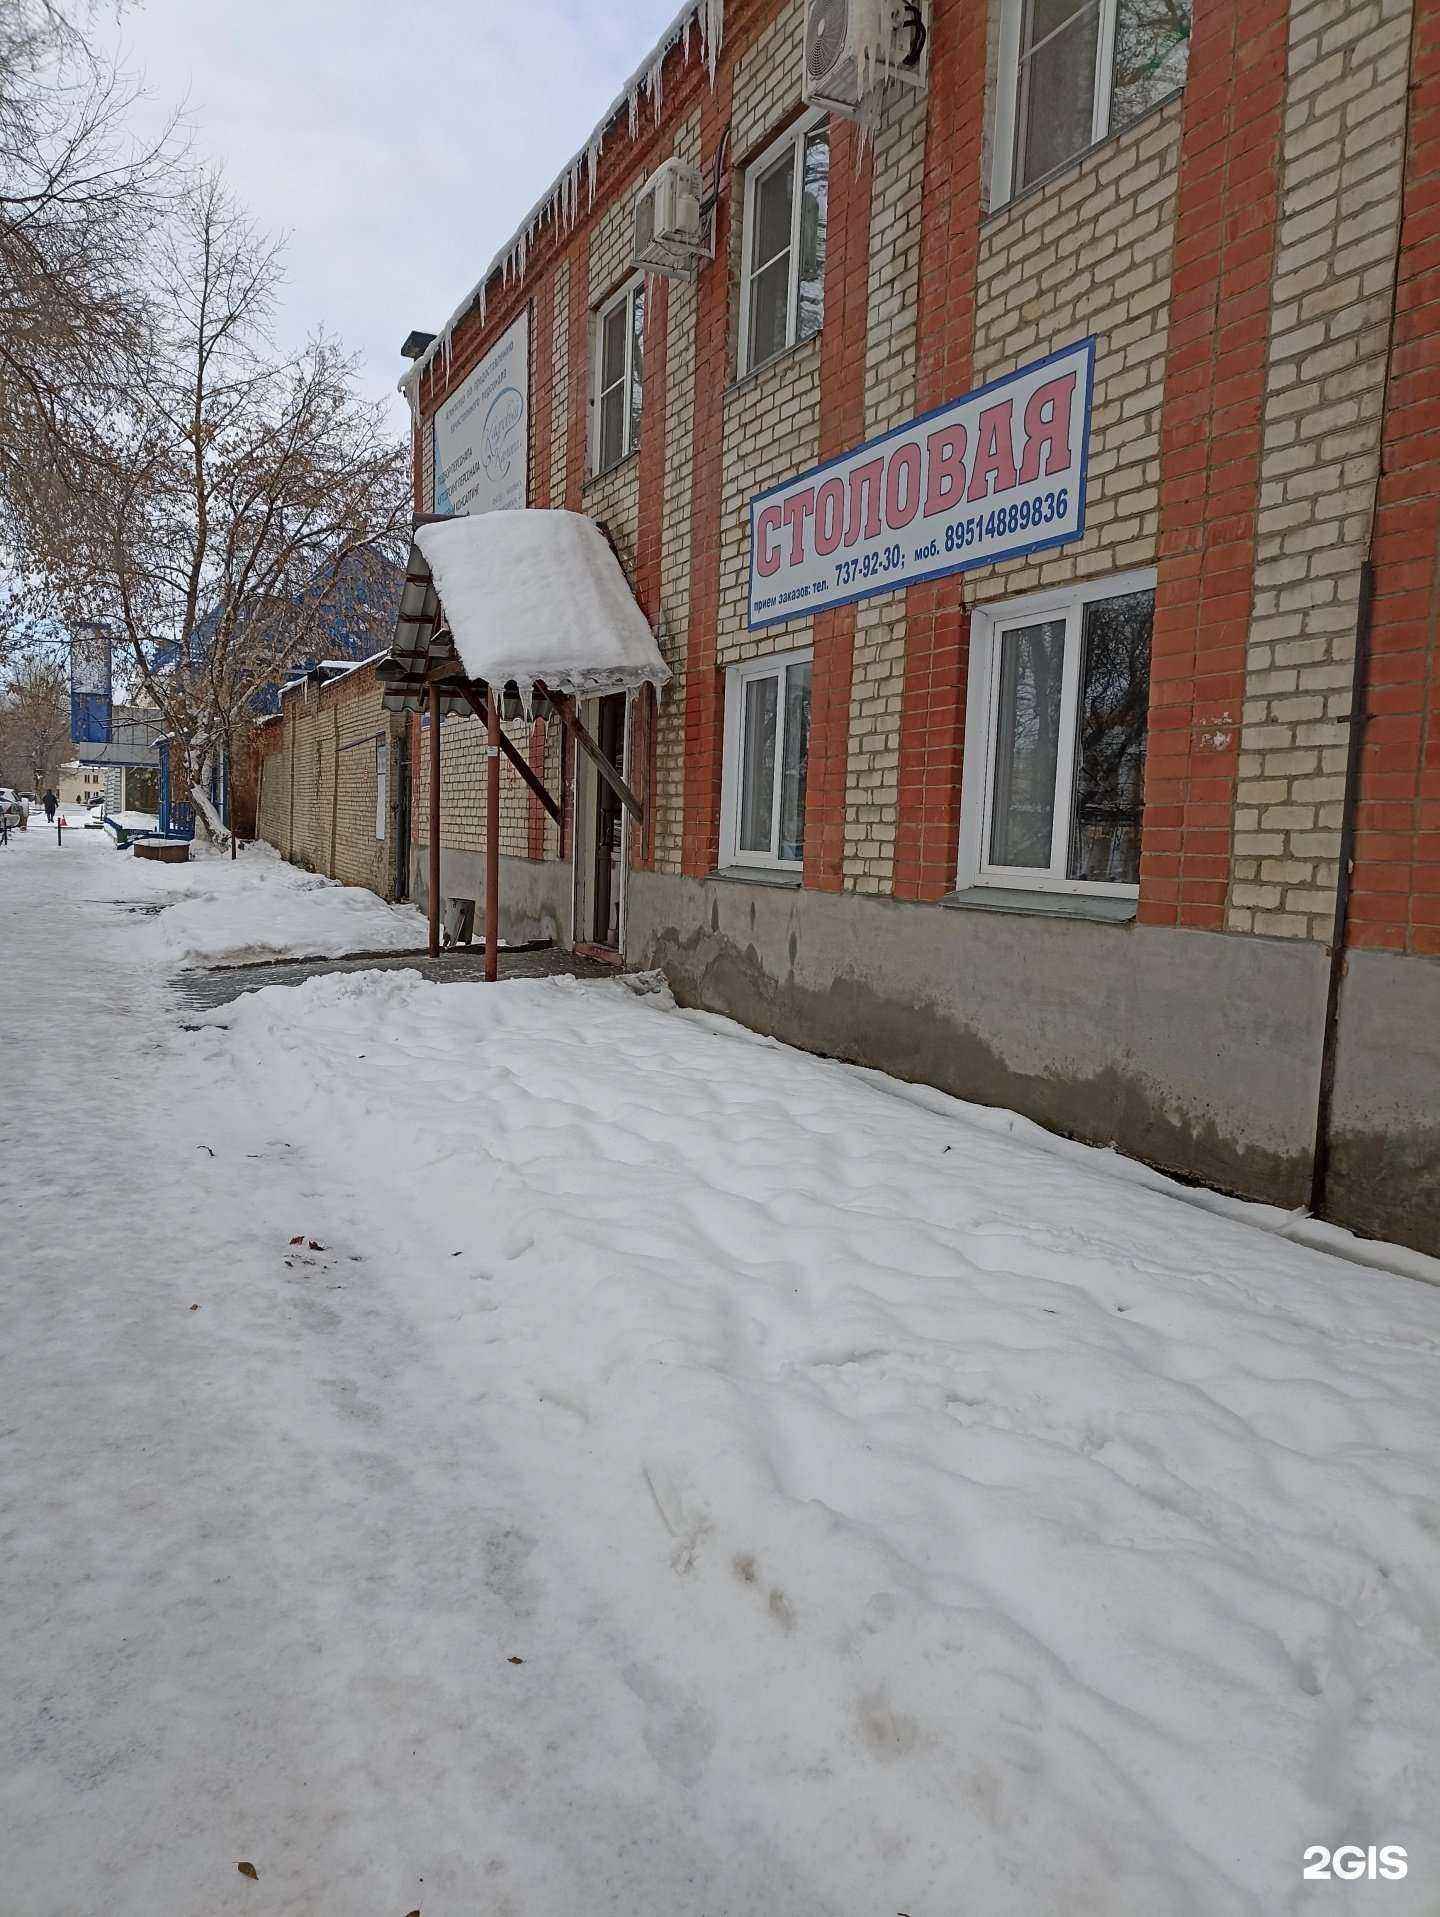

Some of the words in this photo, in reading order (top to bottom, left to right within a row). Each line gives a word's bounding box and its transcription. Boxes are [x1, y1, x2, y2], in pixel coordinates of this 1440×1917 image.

[753, 598, 777, 612] прием
[778, 586, 811, 605] заказов:
[812, 581, 829, 594] тел.
[835, 543, 906, 587] 737-92-30;
[914, 539, 940, 562] моб.
[944, 488, 1069, 552] 89514889836
[756, 371, 1077, 578] СТОЛОВАЯ
